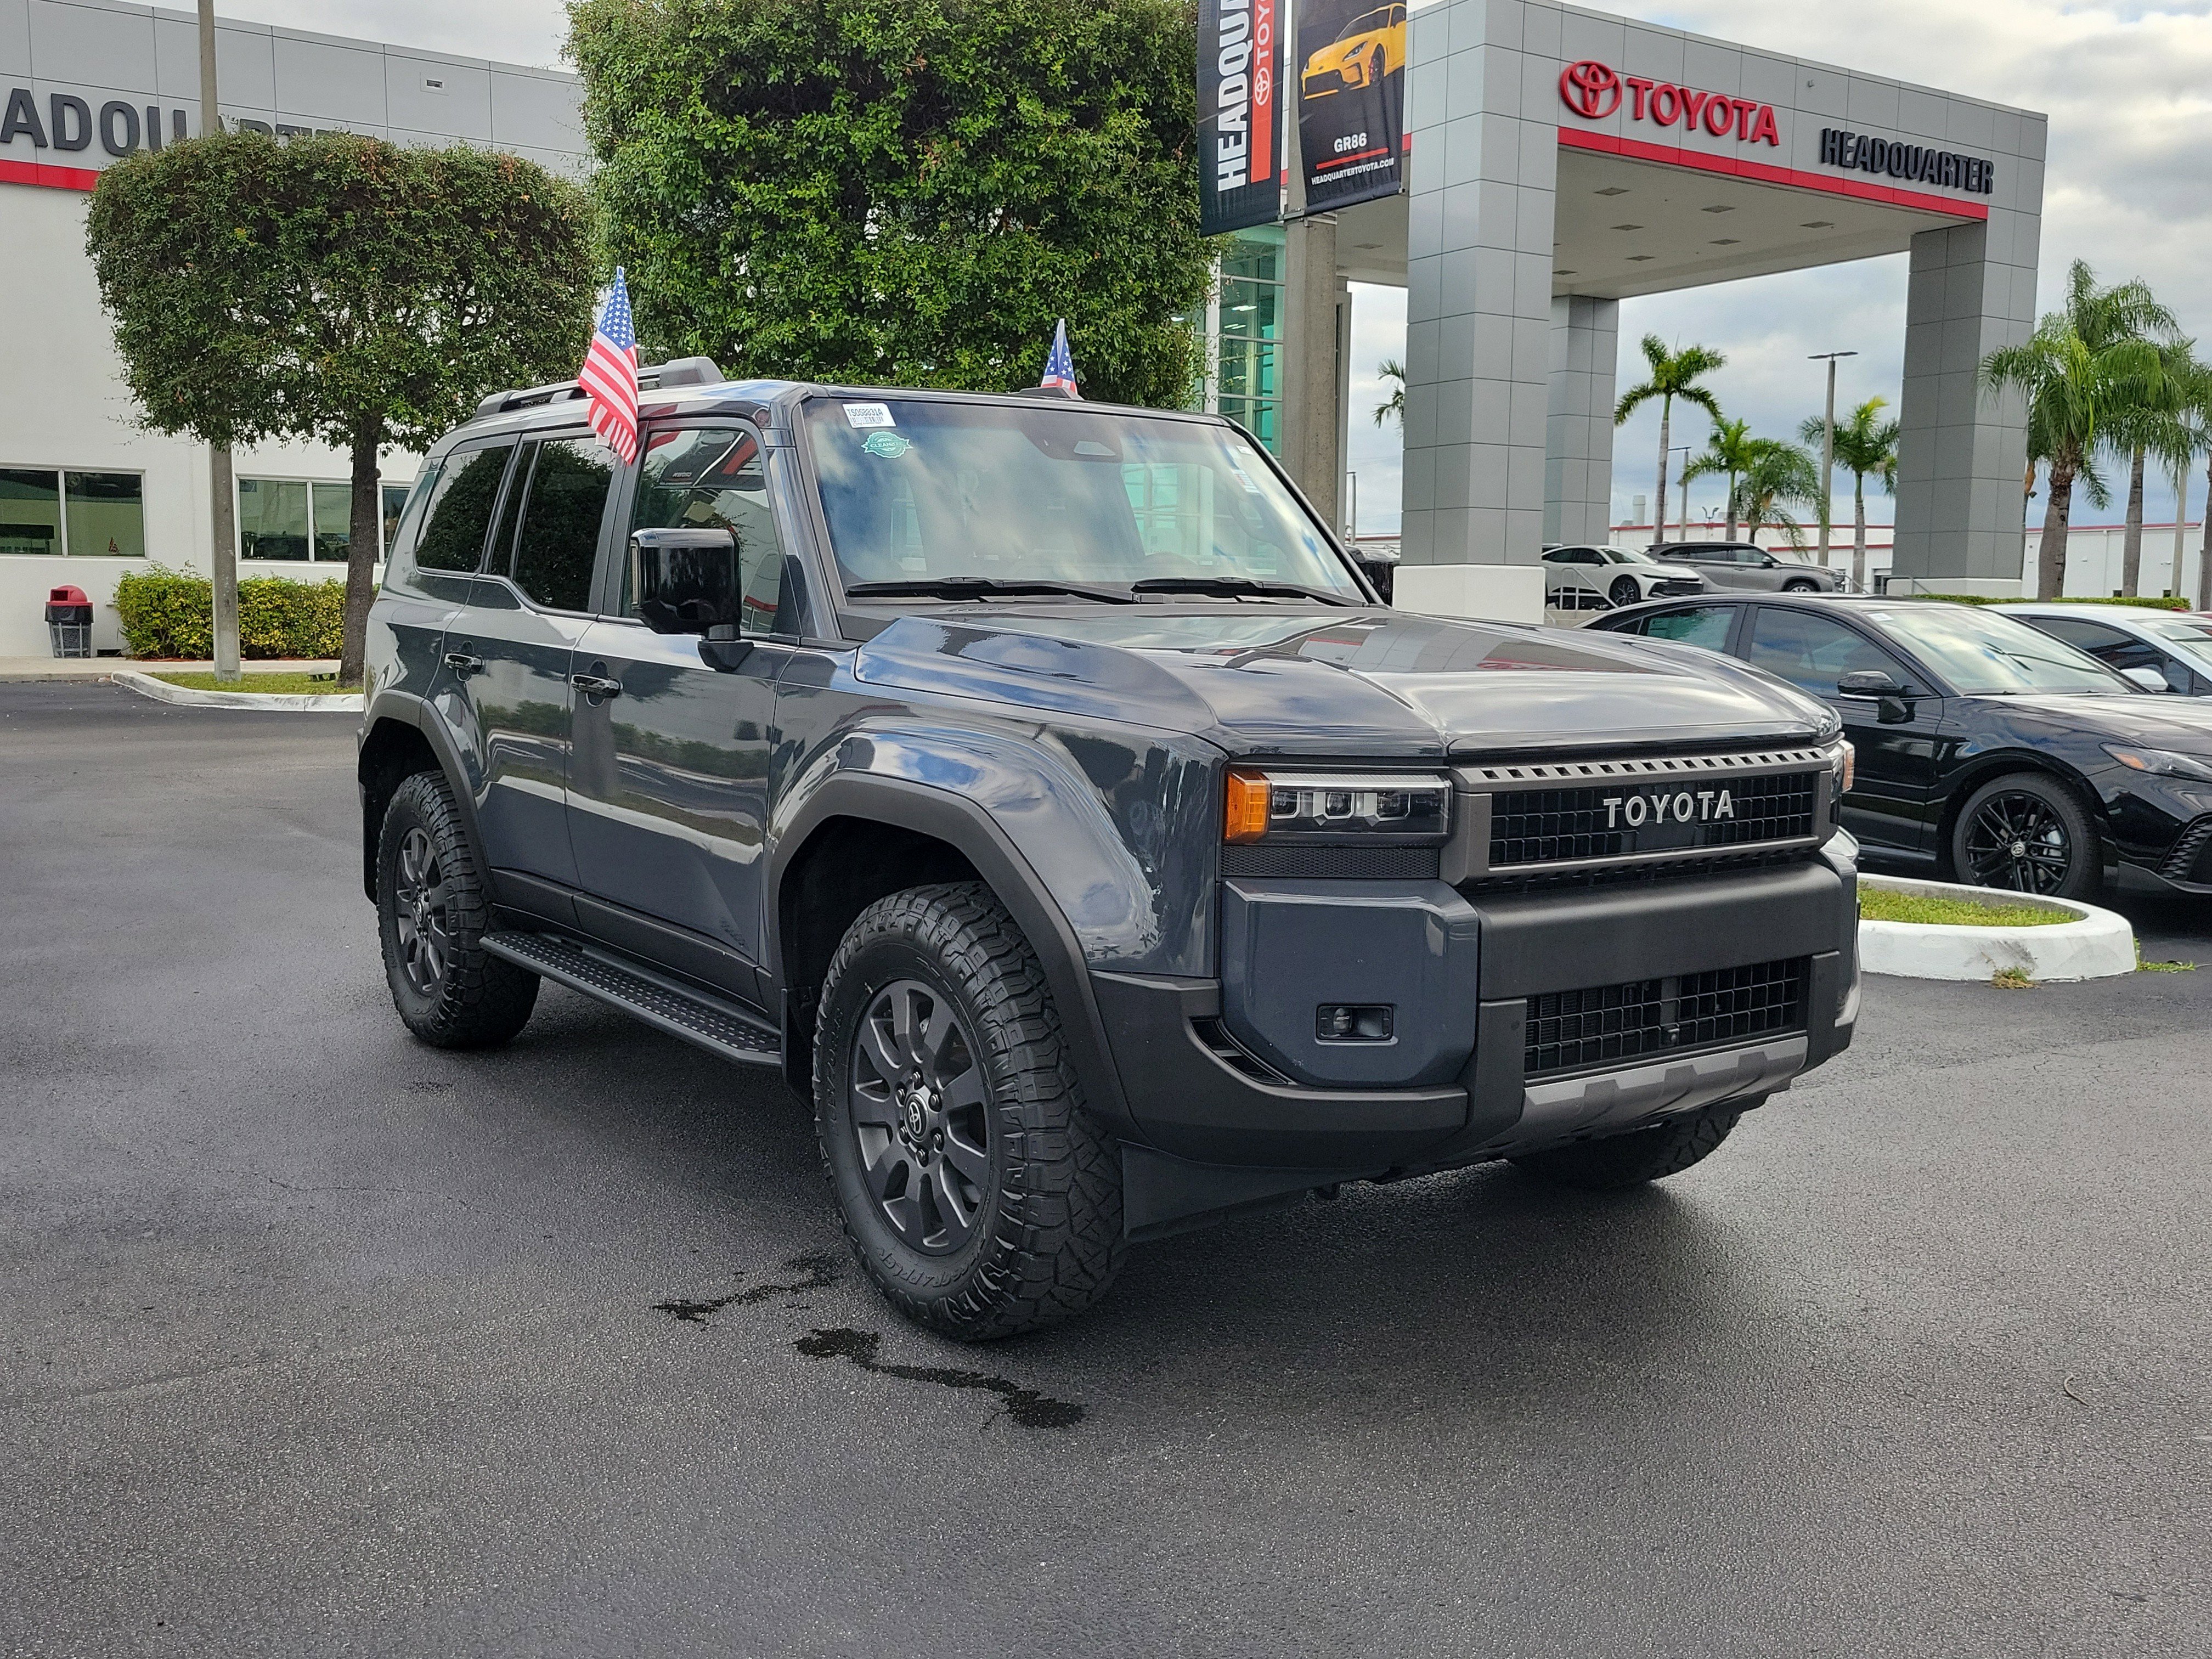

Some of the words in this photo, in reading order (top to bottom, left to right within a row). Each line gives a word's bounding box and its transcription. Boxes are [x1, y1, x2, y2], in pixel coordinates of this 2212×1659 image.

[1256, 0, 1270, 66] TOY
[1627, 77, 1780, 146] TOYOTA
[1334, 132, 1368, 153] GR86
[1820, 128, 1994, 195] HEADQUARTER
[1311, 157, 1395, 186] HEADQUARTERTOYOTA.COM
[1603, 789, 1735, 828] TOYOTA
